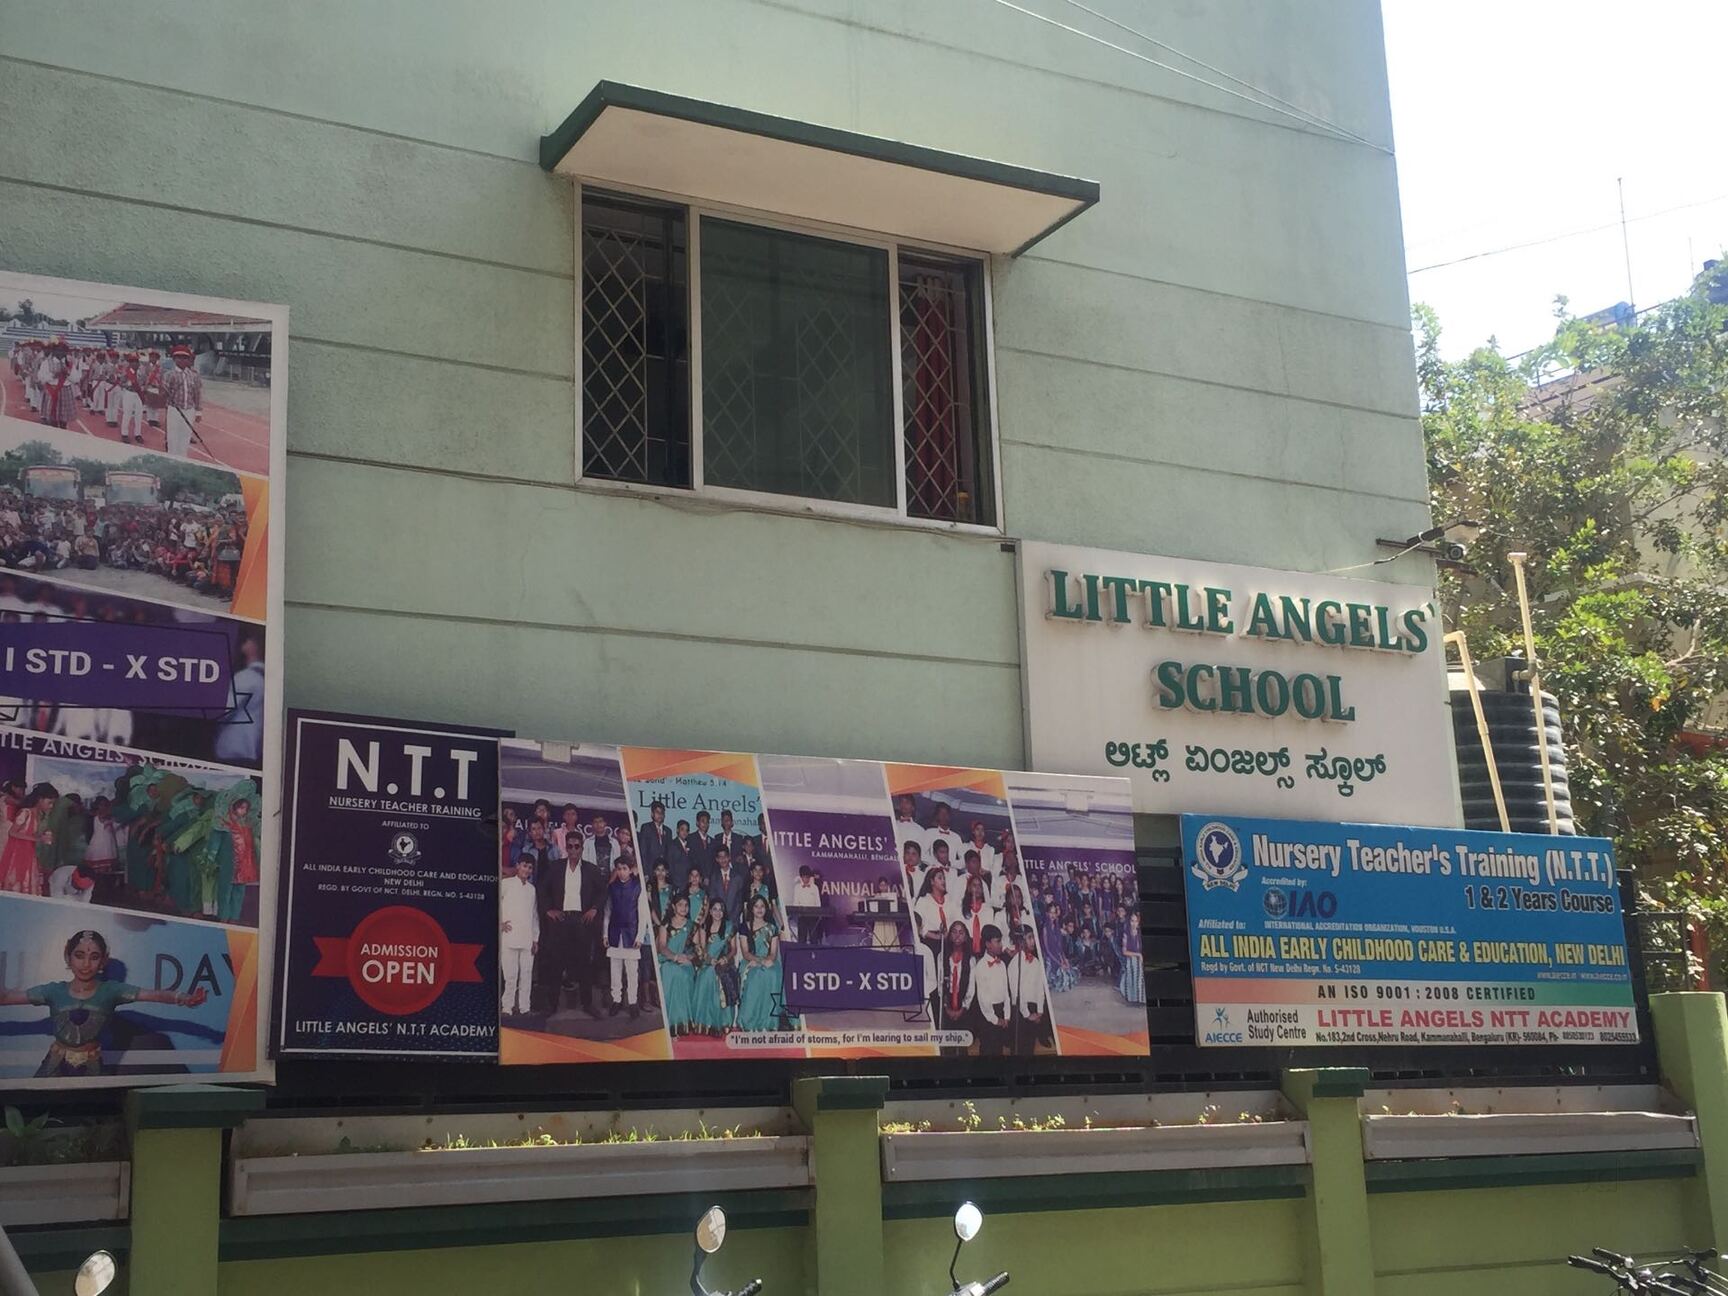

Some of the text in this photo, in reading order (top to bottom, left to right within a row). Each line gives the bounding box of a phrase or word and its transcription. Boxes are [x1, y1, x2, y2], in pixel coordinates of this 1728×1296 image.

[1048, 570, 1436, 654] LITTLE ANGELS'
[5, 647, 14, 671] I
[25, 648, 92, 675] STD
[125, 654, 148, 680] X
[157, 657, 220, 683] STD
[1156, 661, 1356, 722] SCHOOL
[336, 738, 478, 800] N.T.T
[329, 796, 482, 818] NURSERY TEACHER TRAINING
[382, 820, 430, 831] AFFILIATED TO
[819, 833, 888, 851] ANGELS'
[1095, 862, 1137, 874] SCHOOL
[1251, 834, 1341, 878] Nursery
[1346, 839, 1451, 876] Teacher's
[1455, 845, 1541, 886] Training
[1545, 849, 1614, 890] (N.T.T.)
[303, 863, 317, 871] ALL
[318, 864, 341, 873] INDIA
[343, 865, 366, 874] EARLY
[368, 867, 415, 878] CHILDHOOD
[417, 870, 438, 879] CARE
[440, 872, 456, 880] AND
[384, 878, 424, 888] NEW DELHI
[821, 881, 876, 897] ANNUAL
[1288, 890, 1338, 919] IAO
[1465, 885, 1615, 914] 1 & 2 Years Course
[1198, 919, 1233, 930] Affiliated
[1264, 921, 1313, 931] INTERNATIONAL
[1315, 922, 1363, 932] ACCREDITATION
[360, 943, 438, 958] ADMISSION
[1200, 934, 1625, 968] ALL INDIA EARLY CHILDHOOD CARE & EDUCATION, NEW DELHI
[362, 959, 435, 984] OPEN
[792, 972, 797, 990] I
[803, 972, 841, 991] STD
[859, 973, 872, 990] X
[876, 972, 913, 991] STD
[1318, 985, 1336, 999] AN
[1344, 985, 1368, 999] ISO
[1466, 987, 1535, 1000] CERTIFIED
[1247, 1008, 1299, 1024] Authorised
[1318, 1010, 1630, 1029] LITTLE ANGELS NTT ACADEMY
[295, 1020, 331, 1033] LITTLE
[335, 1021, 393, 1036] ANGELS'
[430, 1024, 496, 1037] ACADEMY
[1248, 1025, 1306, 1042] Study Centre
[752, 1035, 766, 1044] not
[769, 1034, 794, 1044] afraid
[796, 1034, 805, 1043] of
[808, 1035, 840, 1046] storms,
[843, 1033, 854, 1043] for
[857, 1033, 870, 1043] I'm
[904, 1034, 912, 1042] to
[914, 1032, 929, 1042] sail
[931, 1034, 943, 1044] my
[1205, 1032, 1242, 1043] AIECCE
